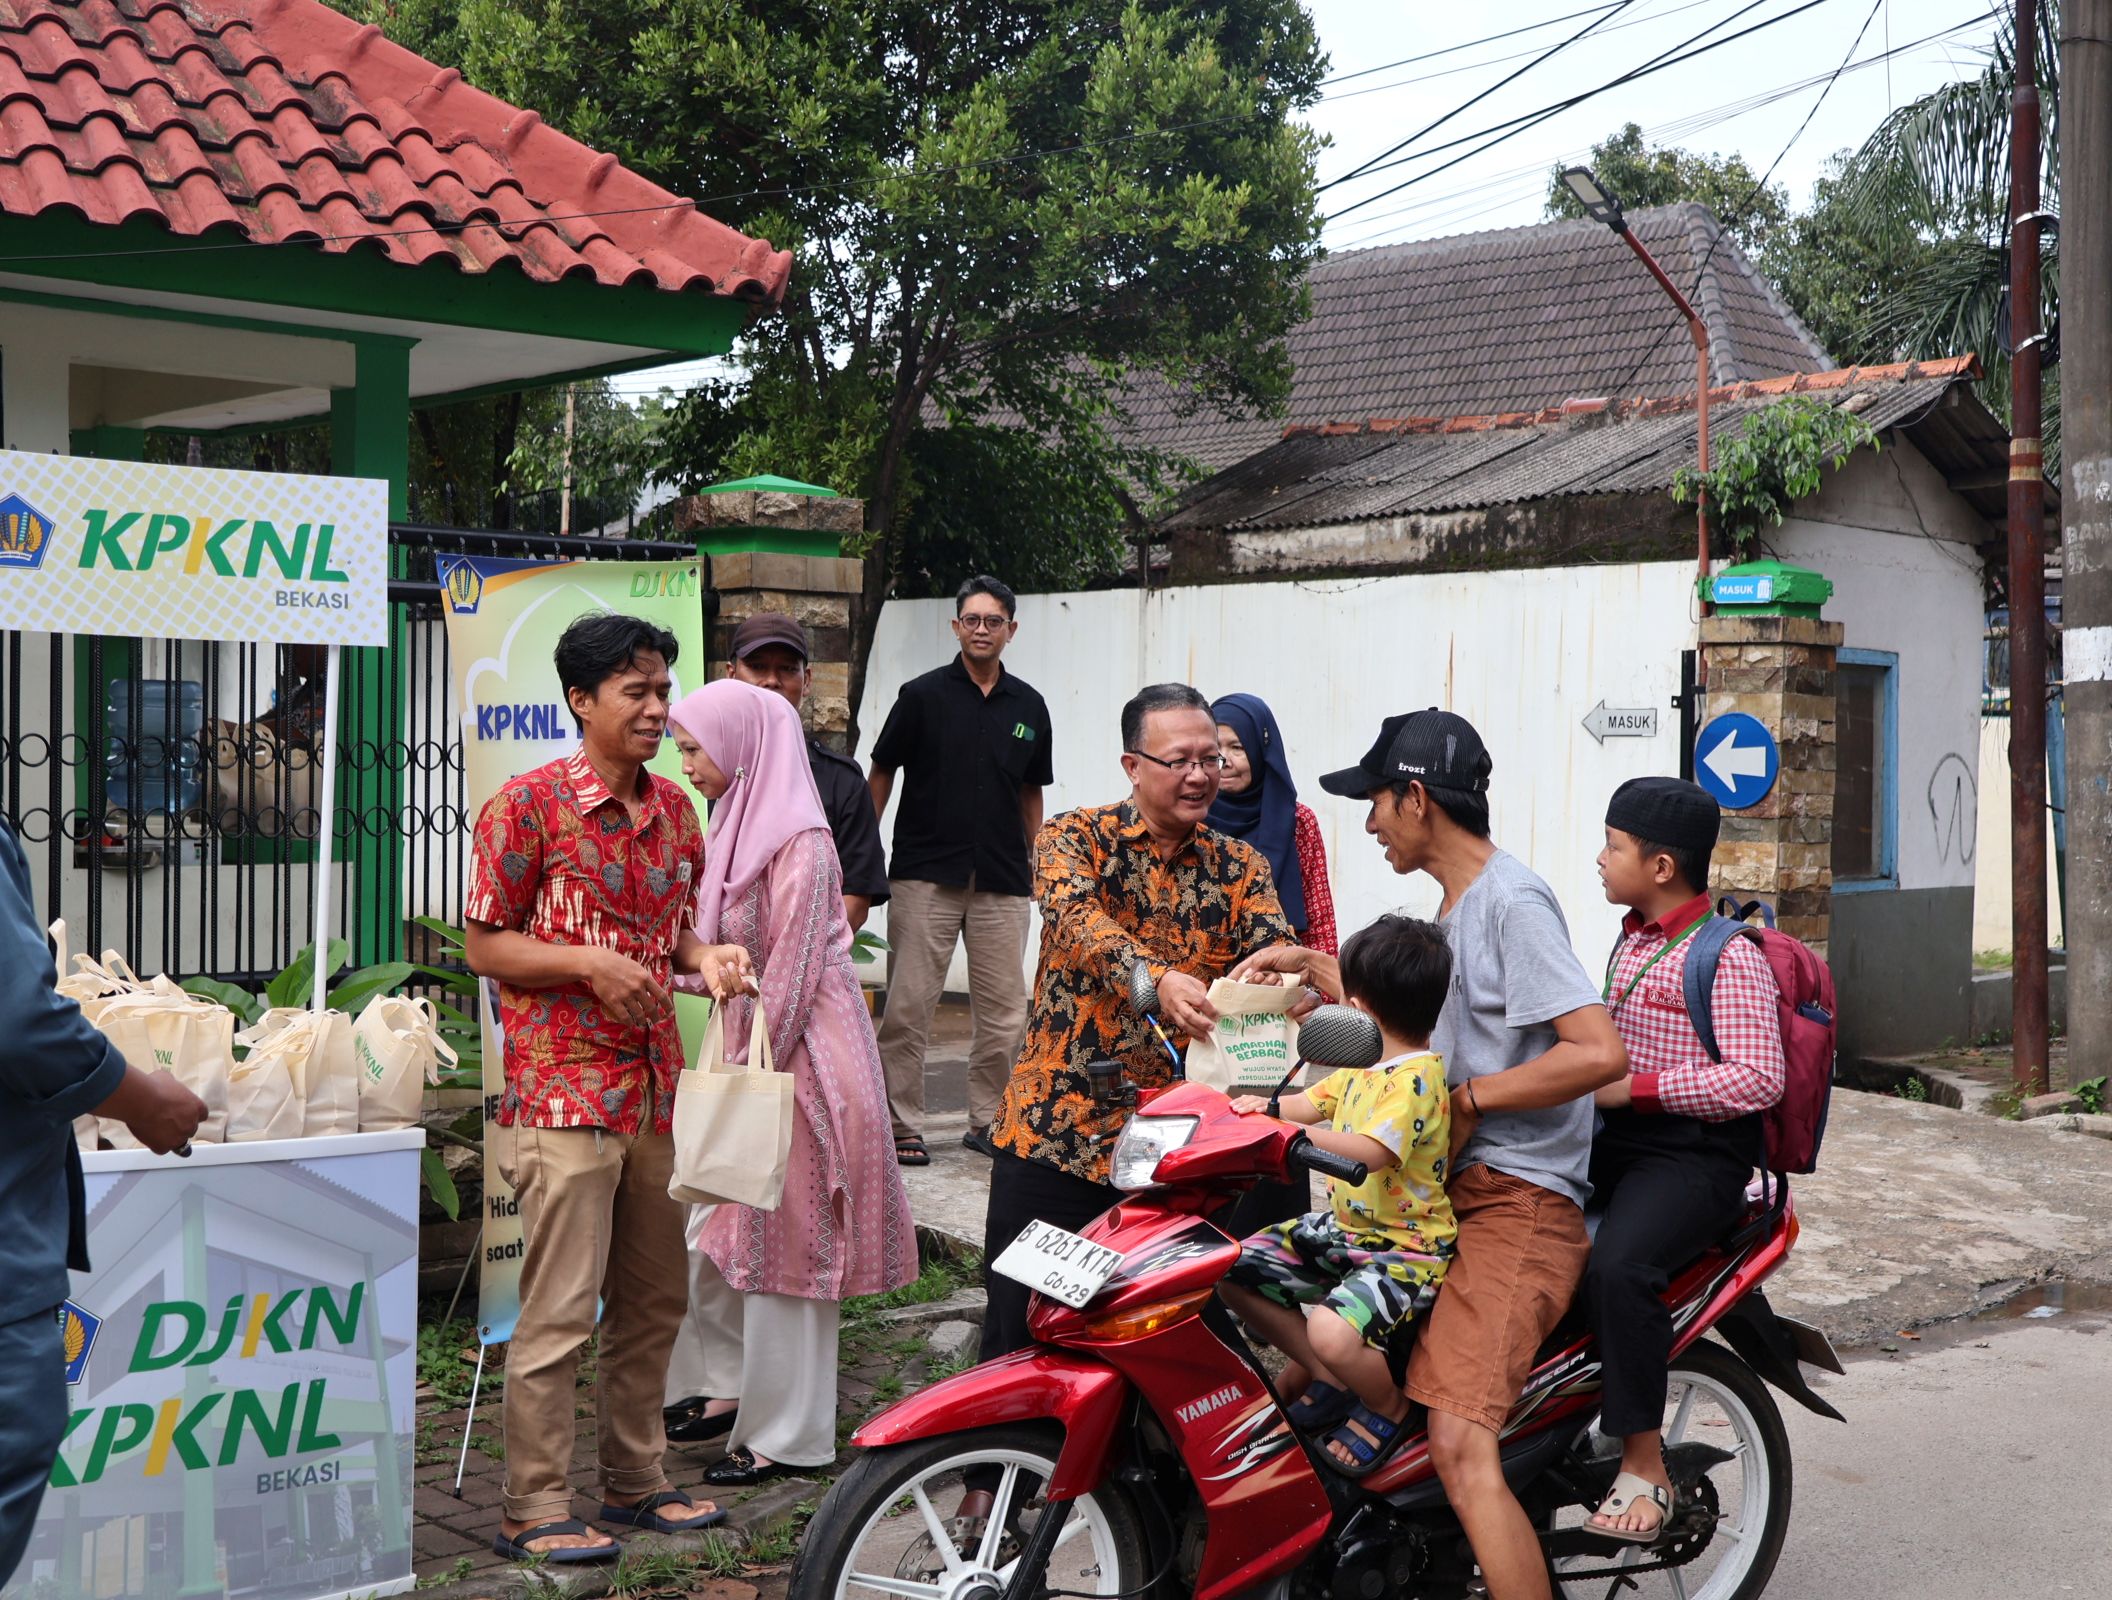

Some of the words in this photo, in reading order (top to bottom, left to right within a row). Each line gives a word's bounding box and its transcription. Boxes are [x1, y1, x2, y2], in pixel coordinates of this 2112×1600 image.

[78, 509, 350, 582] KPKNL
[275, 590, 349, 610] BEKASI
[1719, 585, 1753, 595] MASUK
[477, 703, 566, 741] KPKNL
[1608, 715, 1651, 729] MASUK
[1398, 762, 1426, 775] frozt
[1225, 1040, 1287, 1055] RAMADHAN
[1236, 1048, 1286, 1062] BERBAGI
[486, 1237, 524, 1263] saat
[1017, 1221, 1039, 1243] B
[1035, 1229, 1083, 1261] 6261
[1077, 1245, 1122, 1278] KTA
[1176, 1385, 1243, 1424] YAMAHA
[256, 1461, 341, 1495] BEKASI
